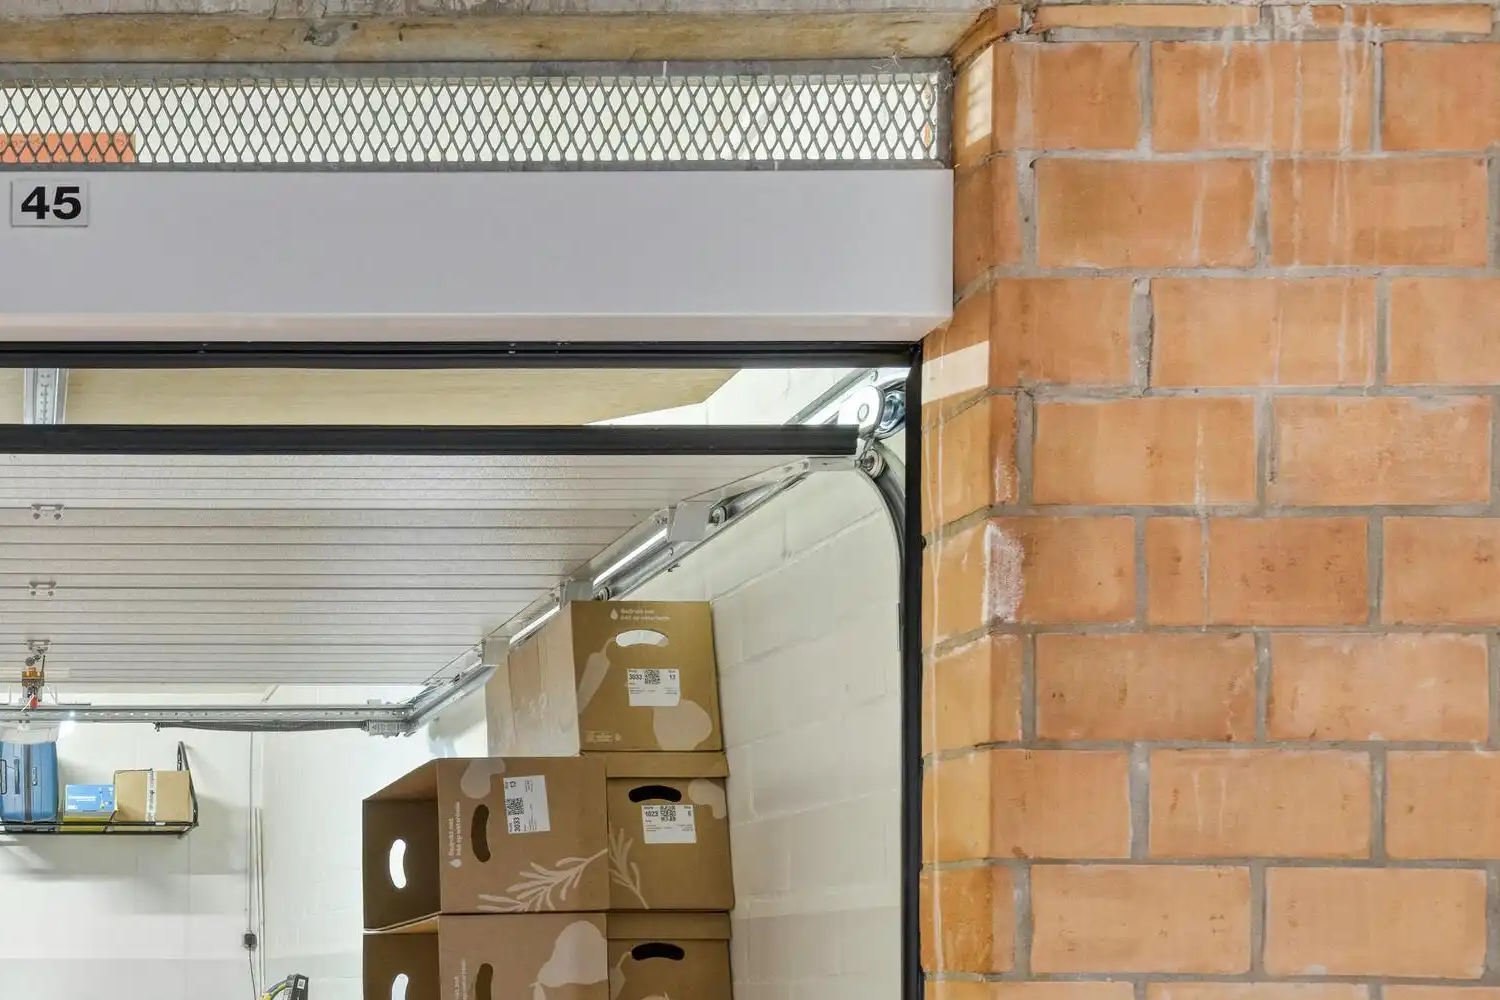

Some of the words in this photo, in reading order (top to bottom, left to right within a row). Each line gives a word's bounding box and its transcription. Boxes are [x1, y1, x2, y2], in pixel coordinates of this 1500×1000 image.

[20, 185, 82, 220] 45
[509, 780, 516, 788] 13
[513, 817, 521, 833] 3033
